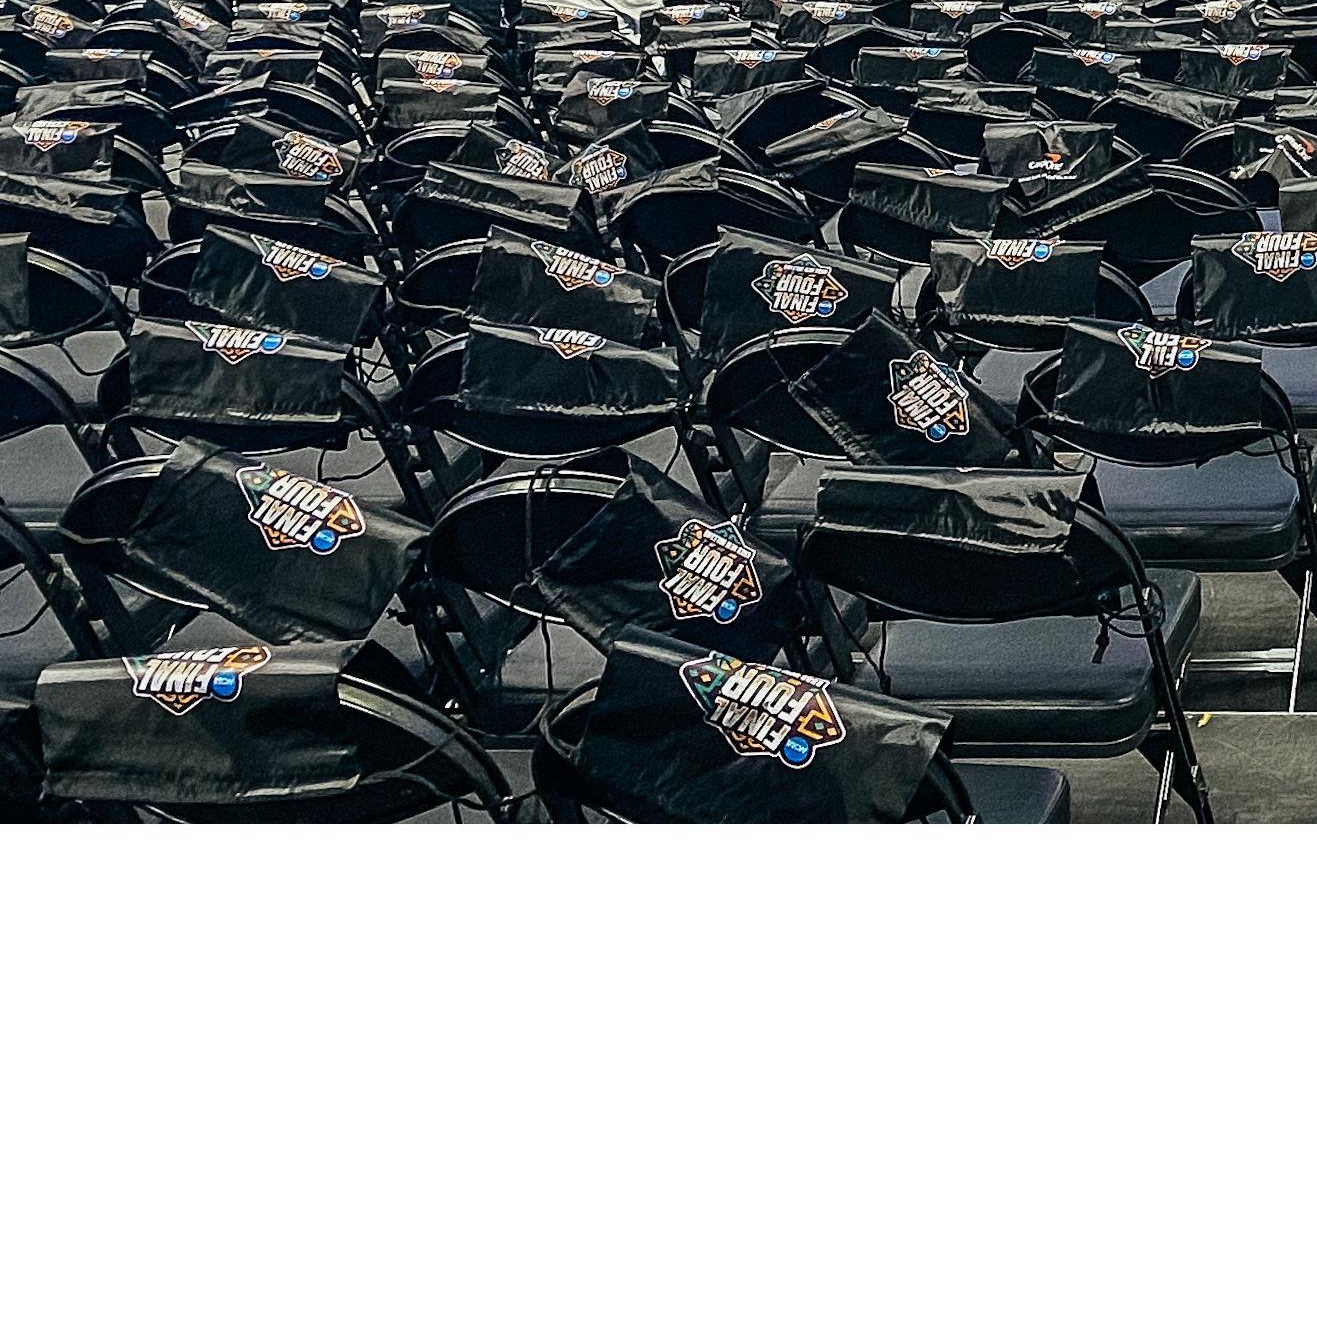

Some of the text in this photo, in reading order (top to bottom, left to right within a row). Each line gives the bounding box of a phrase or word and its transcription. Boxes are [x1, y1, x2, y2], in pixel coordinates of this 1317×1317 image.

[266, 245, 313, 275] FINAL
[988, 240, 1037, 260] FINAL
[1255, 249, 1301, 271] FINAL
[1256, 233, 1304, 255] FOUR
[550, 254, 601, 283] FINAL
[776, 274, 824, 297] FOUR
[773, 291, 820, 314] FINAL
[207, 328, 268, 350] FINAL
[896, 390, 943, 431] FINAL
[910, 371, 963, 421] FOUR
[268, 474, 343, 518] FOUR
[252, 494, 323, 543] FINAL
[684, 545, 748, 585] FOUR
[668, 567, 728, 615] FINAL
[138, 658, 222, 695] FINAL
[720, 663, 820, 711] FOUR
[708, 693, 791, 754] FINAL
